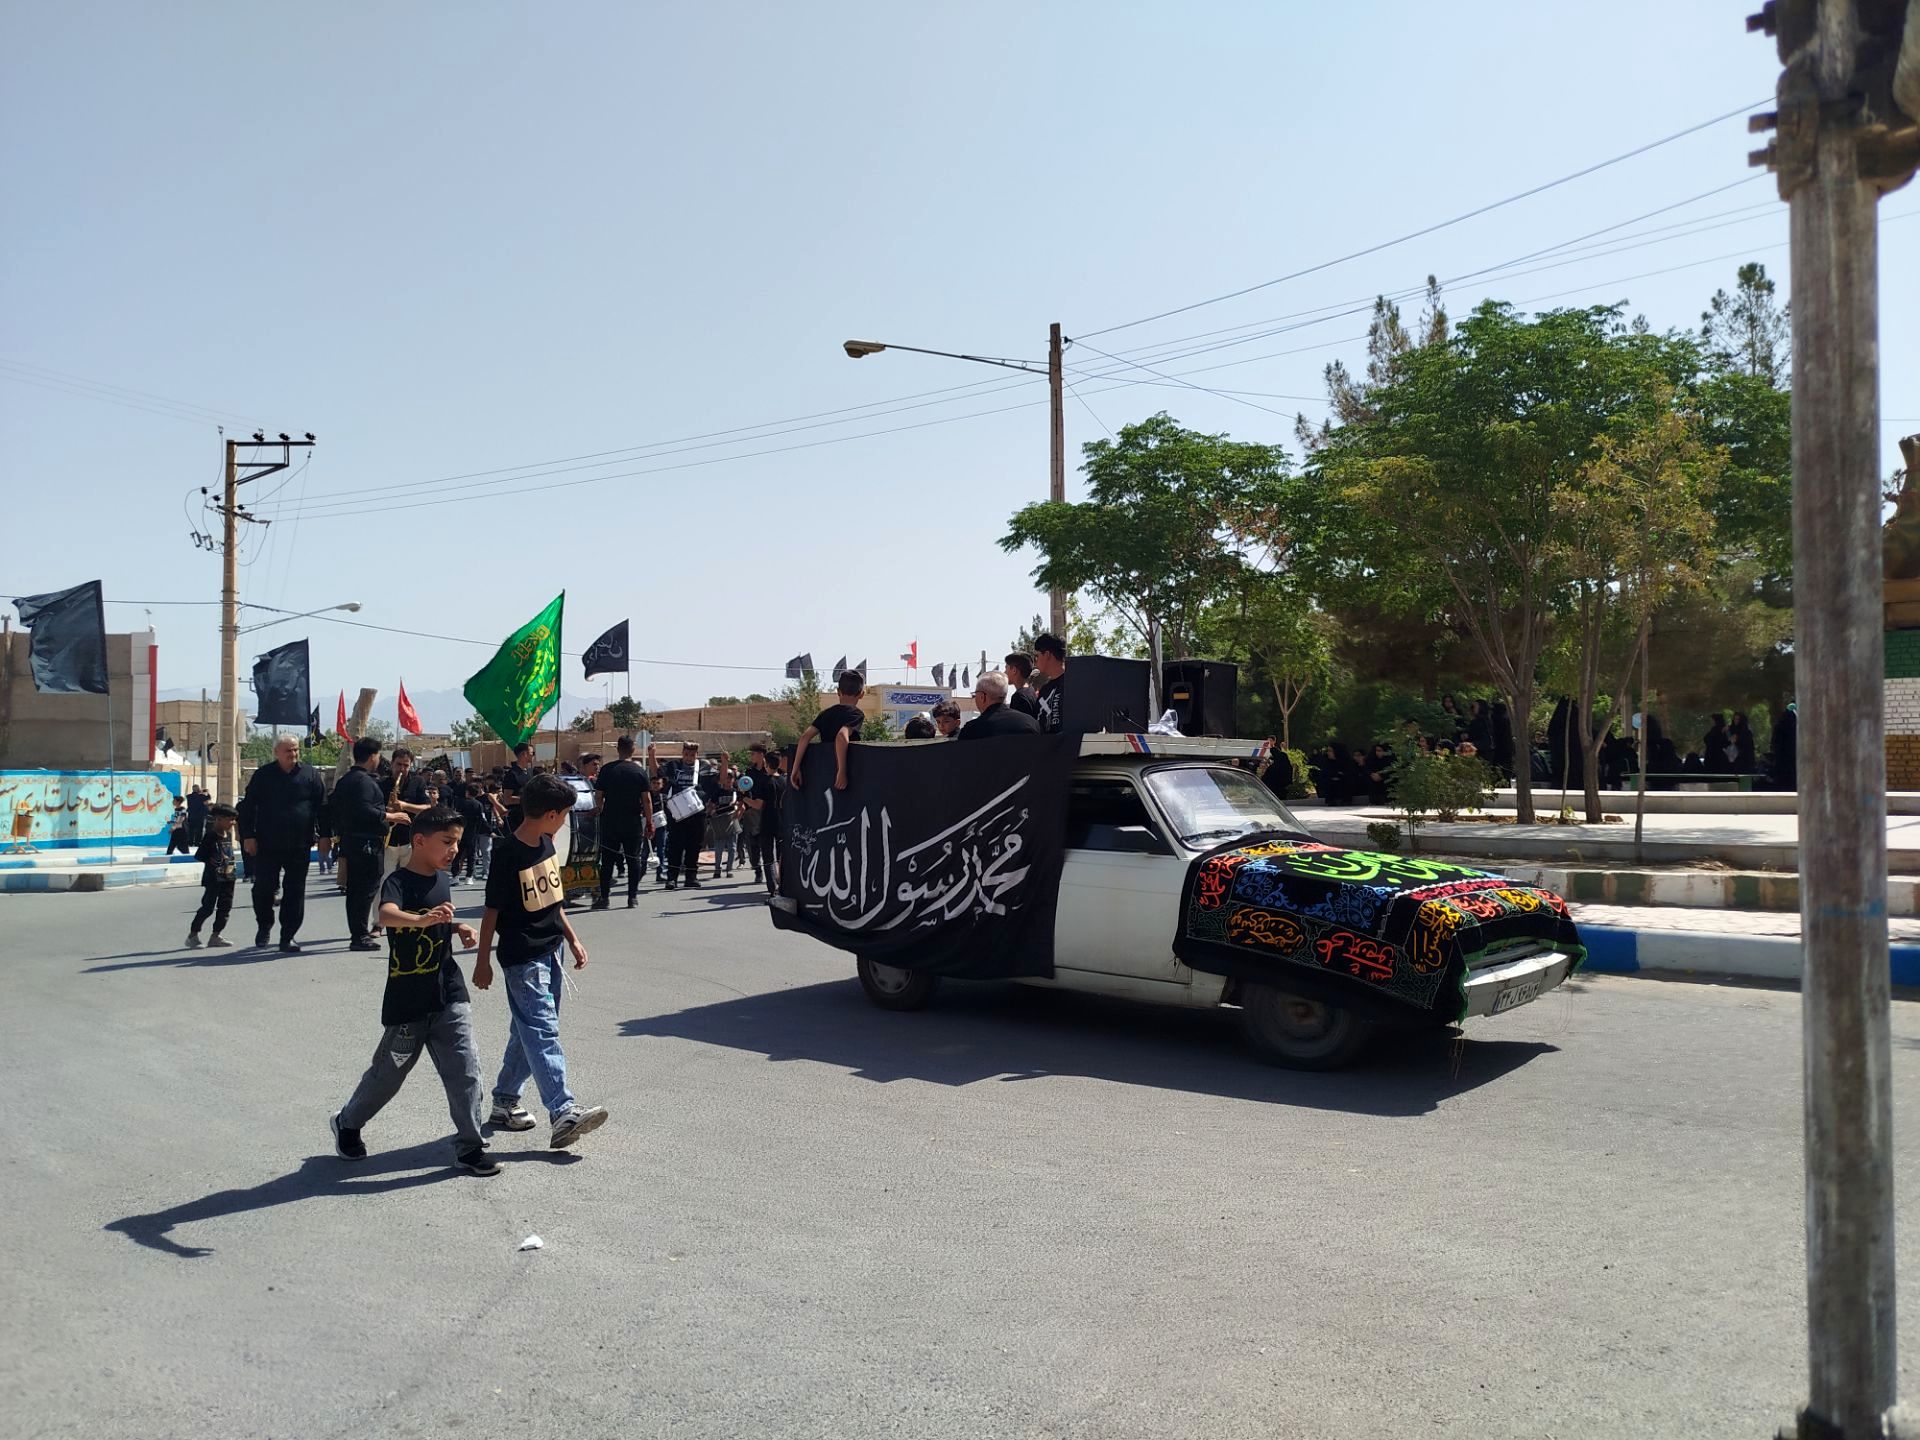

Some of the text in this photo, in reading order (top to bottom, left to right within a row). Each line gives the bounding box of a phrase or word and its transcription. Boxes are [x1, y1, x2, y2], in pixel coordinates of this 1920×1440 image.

[1052, 693, 1061, 725] VIKING
[44, 787, 83, 828] حیات
[121, 783, 164, 814] شهادت
[522, 870, 560, 902] HOG
